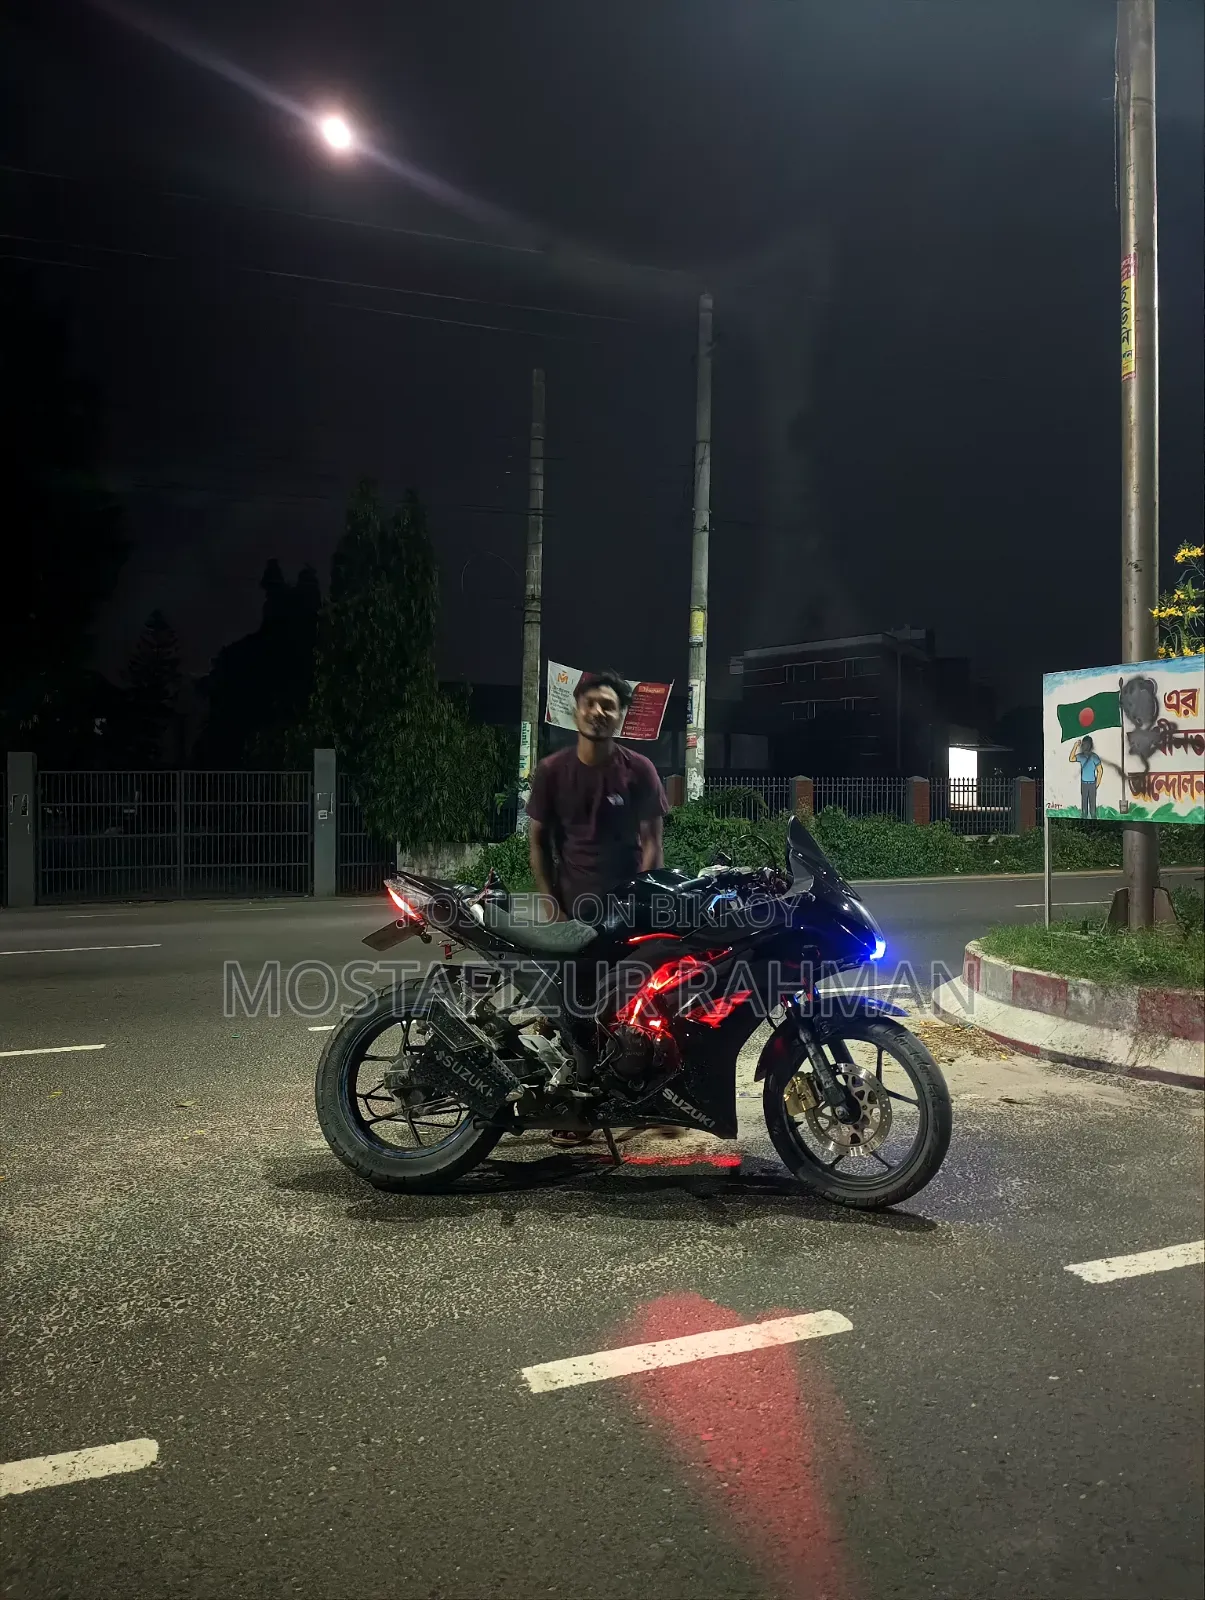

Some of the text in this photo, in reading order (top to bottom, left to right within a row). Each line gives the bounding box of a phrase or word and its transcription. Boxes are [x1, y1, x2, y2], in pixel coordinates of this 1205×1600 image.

[1164, 687, 1200, 718] এর
[442, 1055, 493, 1097] SUZUKI
[662, 1087, 716, 1129] SUZUKI
